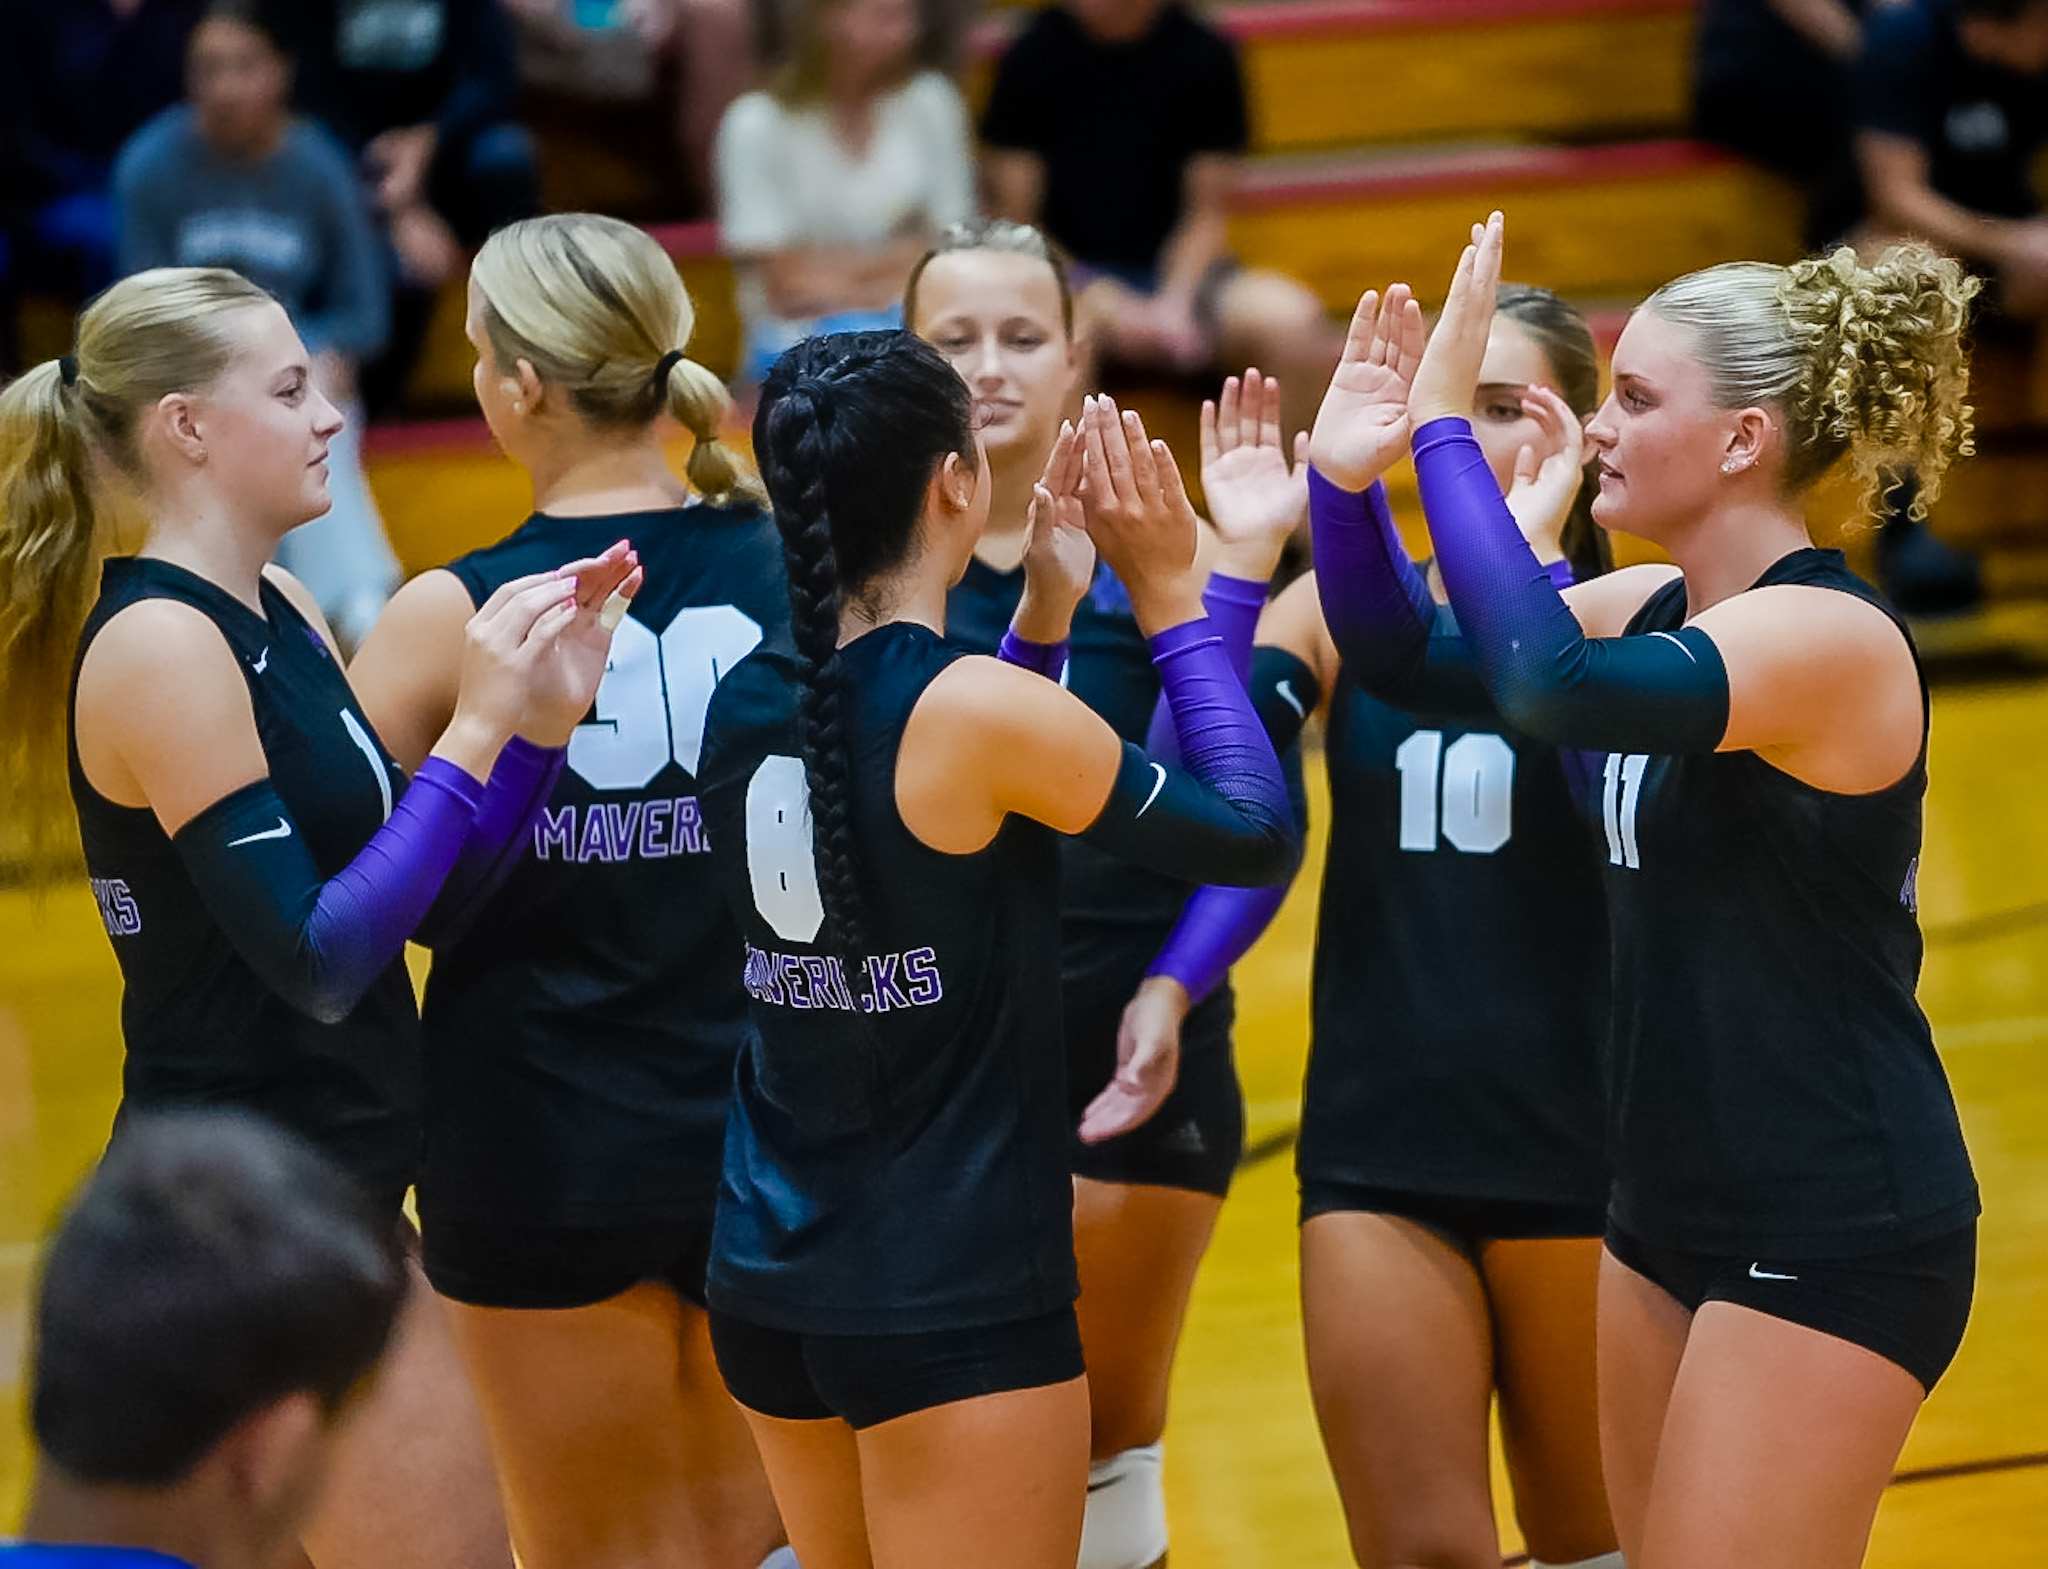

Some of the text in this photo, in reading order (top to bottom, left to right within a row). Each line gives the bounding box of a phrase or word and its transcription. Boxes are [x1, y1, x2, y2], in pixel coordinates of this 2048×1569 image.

[567, 604, 763, 789] 30
[534, 796, 712, 863] MAVER
[744, 754, 826, 943] 8
[1395, 729, 1513, 853] 10
[1603, 752, 1649, 870] 11
